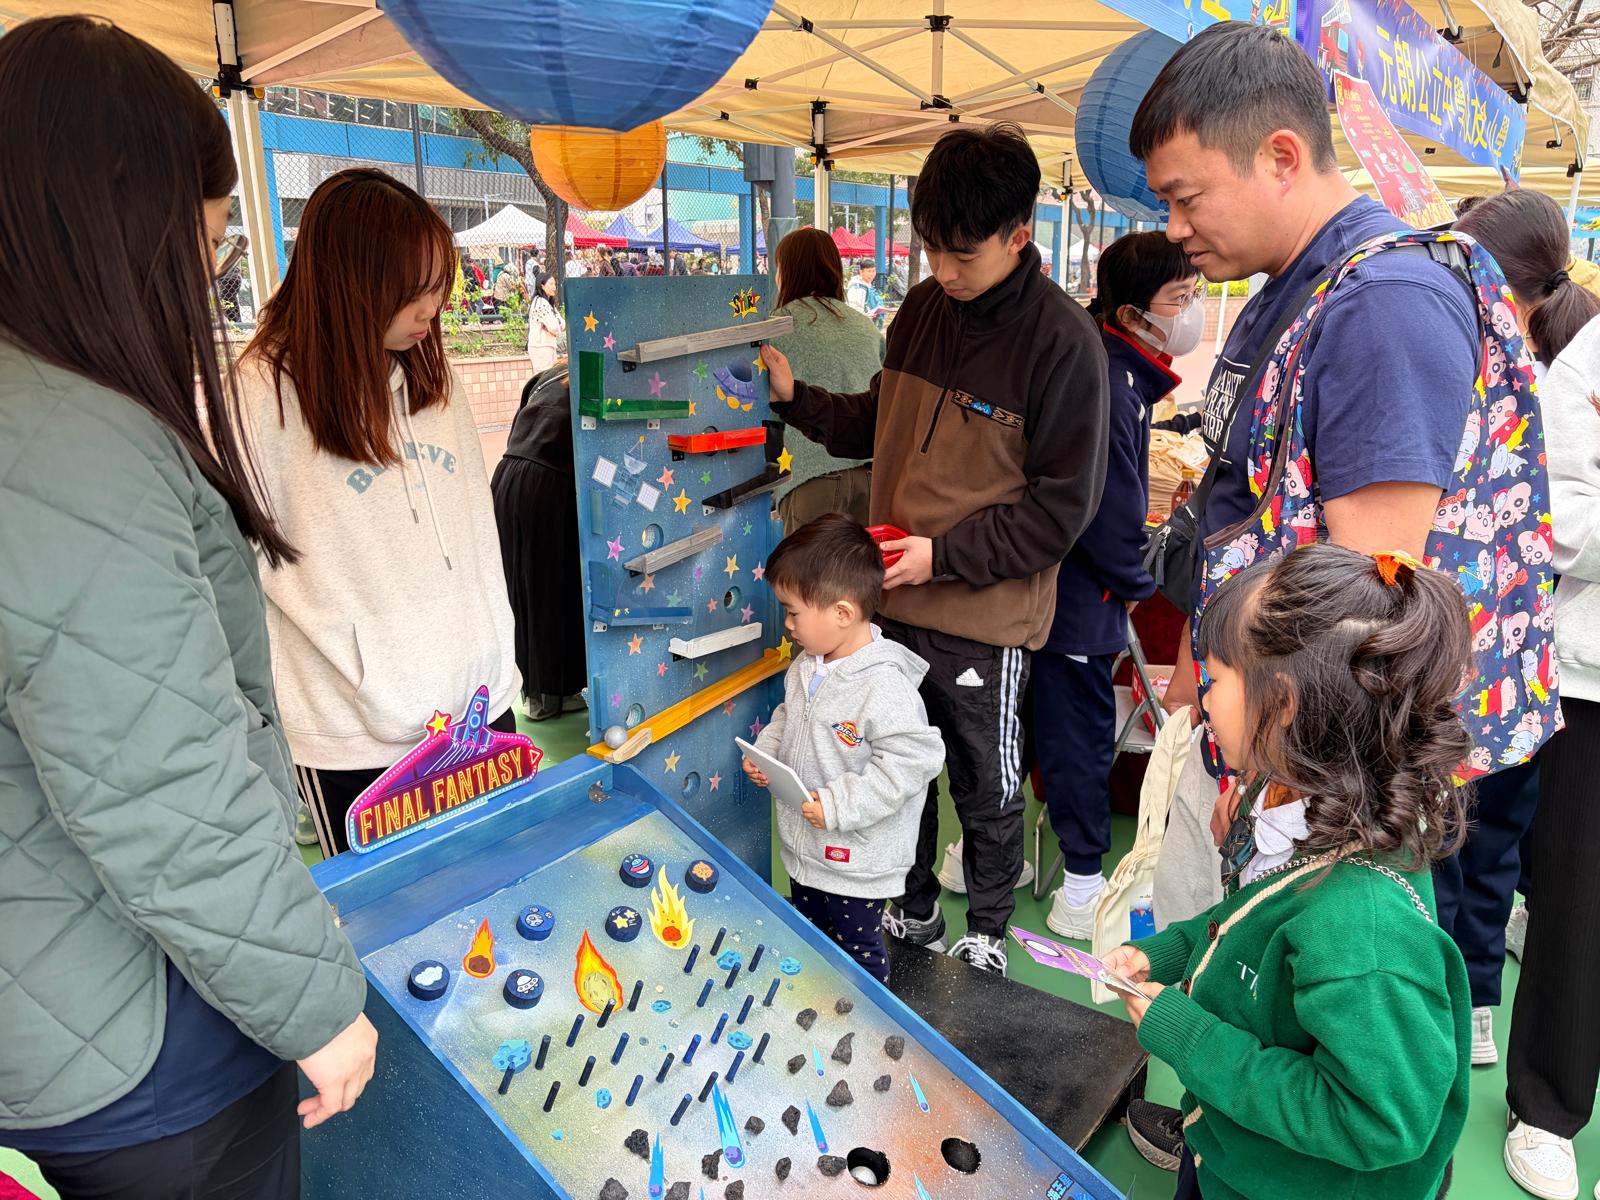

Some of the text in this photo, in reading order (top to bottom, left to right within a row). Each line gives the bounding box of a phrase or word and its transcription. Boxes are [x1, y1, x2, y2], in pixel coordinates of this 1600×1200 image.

[345, 441, 456, 495] BIEVE
[359, 746, 524, 846] FINAL FANTASY
